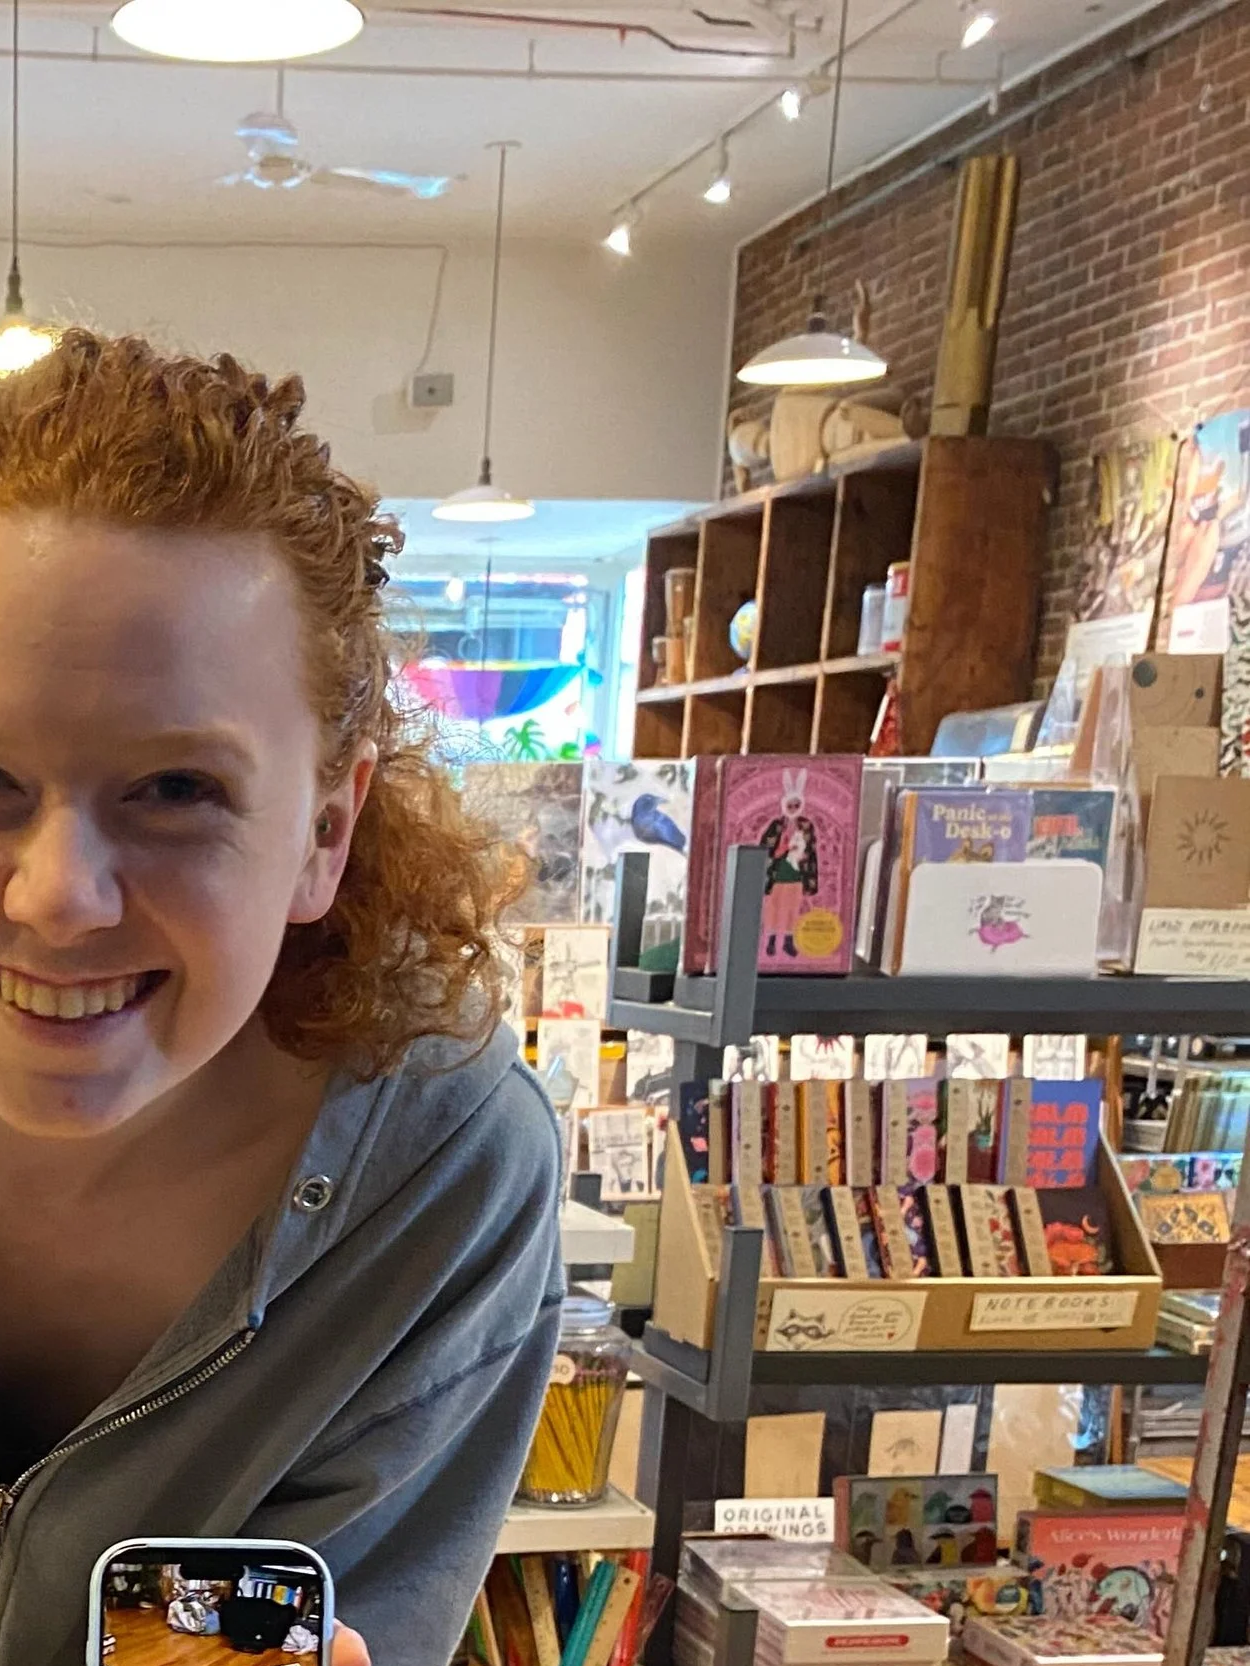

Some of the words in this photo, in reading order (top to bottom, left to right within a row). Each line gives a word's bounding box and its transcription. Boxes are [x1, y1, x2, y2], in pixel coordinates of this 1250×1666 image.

[933, 803, 986, 822] Panic
[945, 822, 1012, 839] Desk-o
[723, 1505, 825, 1521] ORIGINAL
